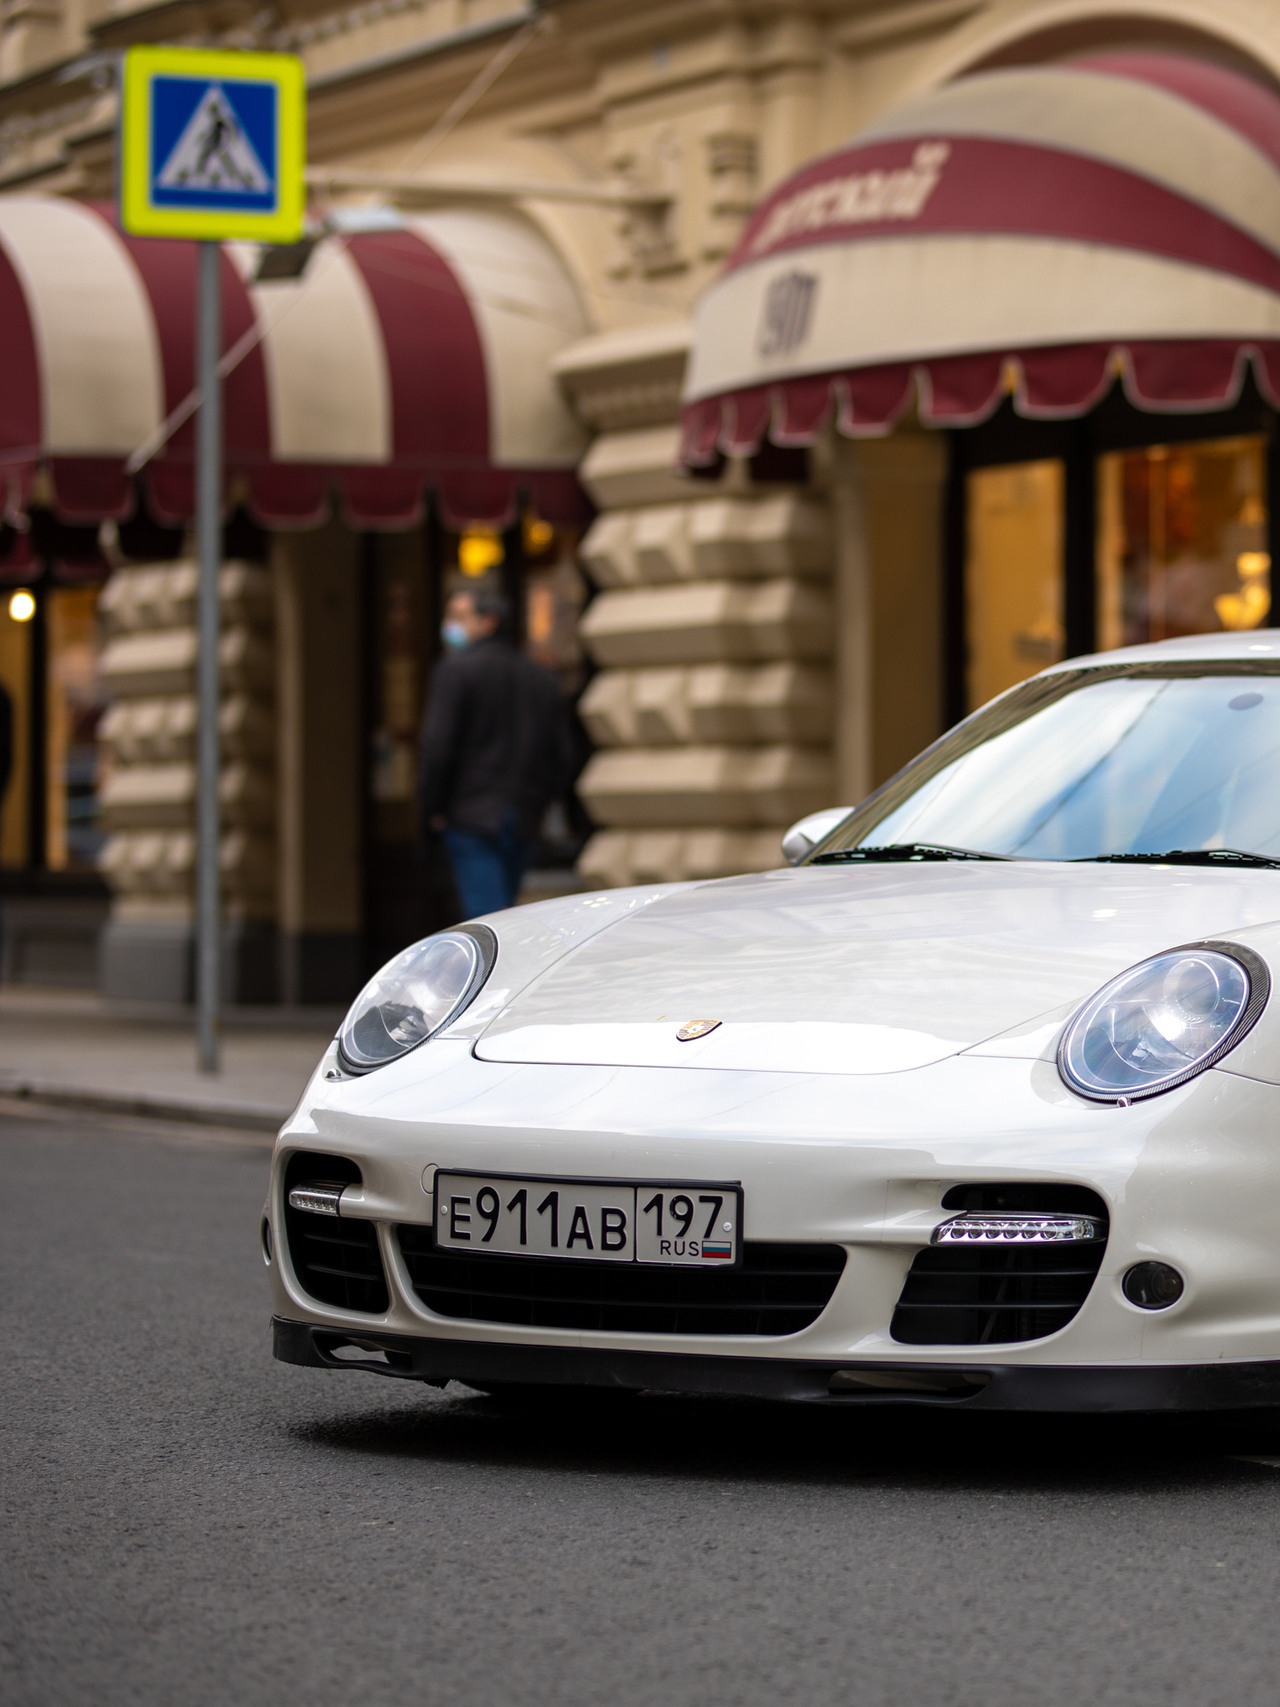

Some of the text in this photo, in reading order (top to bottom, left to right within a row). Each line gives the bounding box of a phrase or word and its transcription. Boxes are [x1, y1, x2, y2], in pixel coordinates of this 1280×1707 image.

[450, 1186, 724, 1251] E911AB 197
[660, 1239, 700, 1257] RUS
